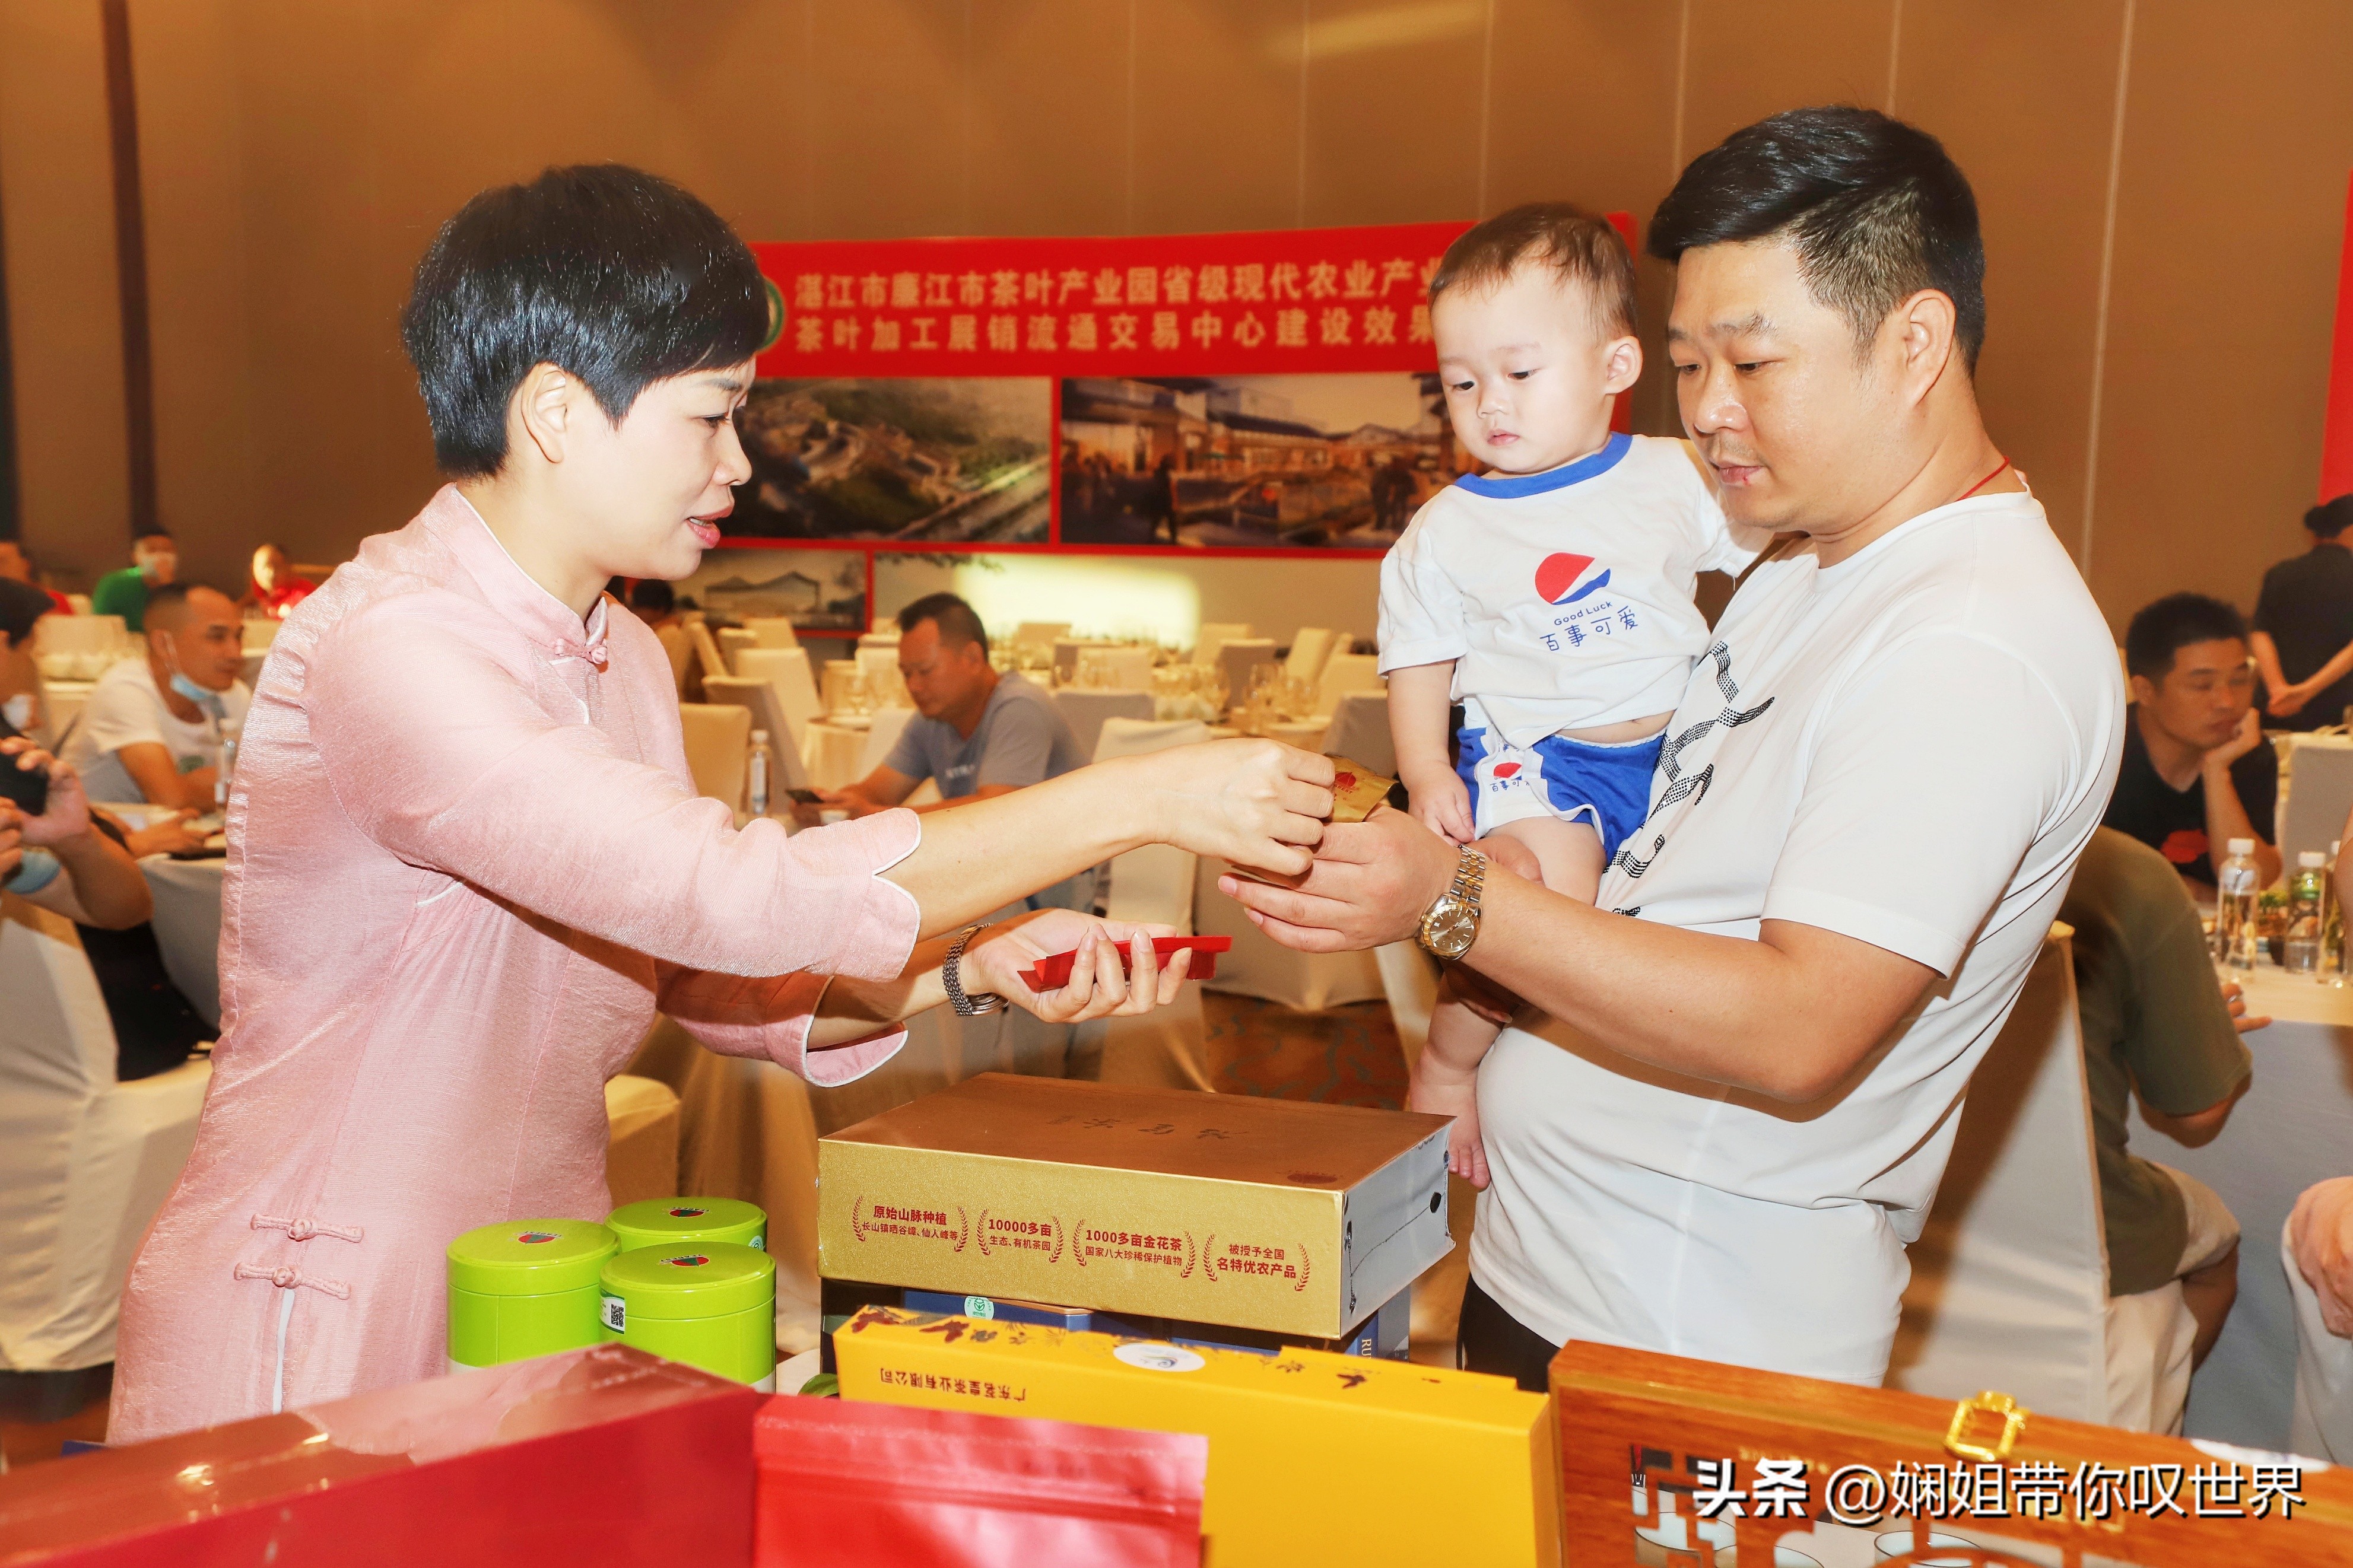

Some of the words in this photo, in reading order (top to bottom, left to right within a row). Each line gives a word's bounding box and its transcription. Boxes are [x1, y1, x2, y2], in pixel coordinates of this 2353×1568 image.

[1554, 610, 1583, 626] Good
[1586, 601, 1613, 615] Luck
[874, 1206, 947, 1226] 原始山脉种植
[989, 1219, 1052, 1236] 10000多亩
[989, 1235, 1050, 1251] 生态、有机茶园
[1086, 1230, 1182, 1251] 1000多亩金花茶
[1085, 1246, 1182, 1266] 国家八大珍稀保护植物
[1228, 1243, 1284, 1260] 被授予全国
[1217, 1257, 1296, 1278] 名特优农产品
[1361, 1338, 1372, 1357] RU
[880, 1367, 1025, 1402] 广东茗皇茶业有限公司
